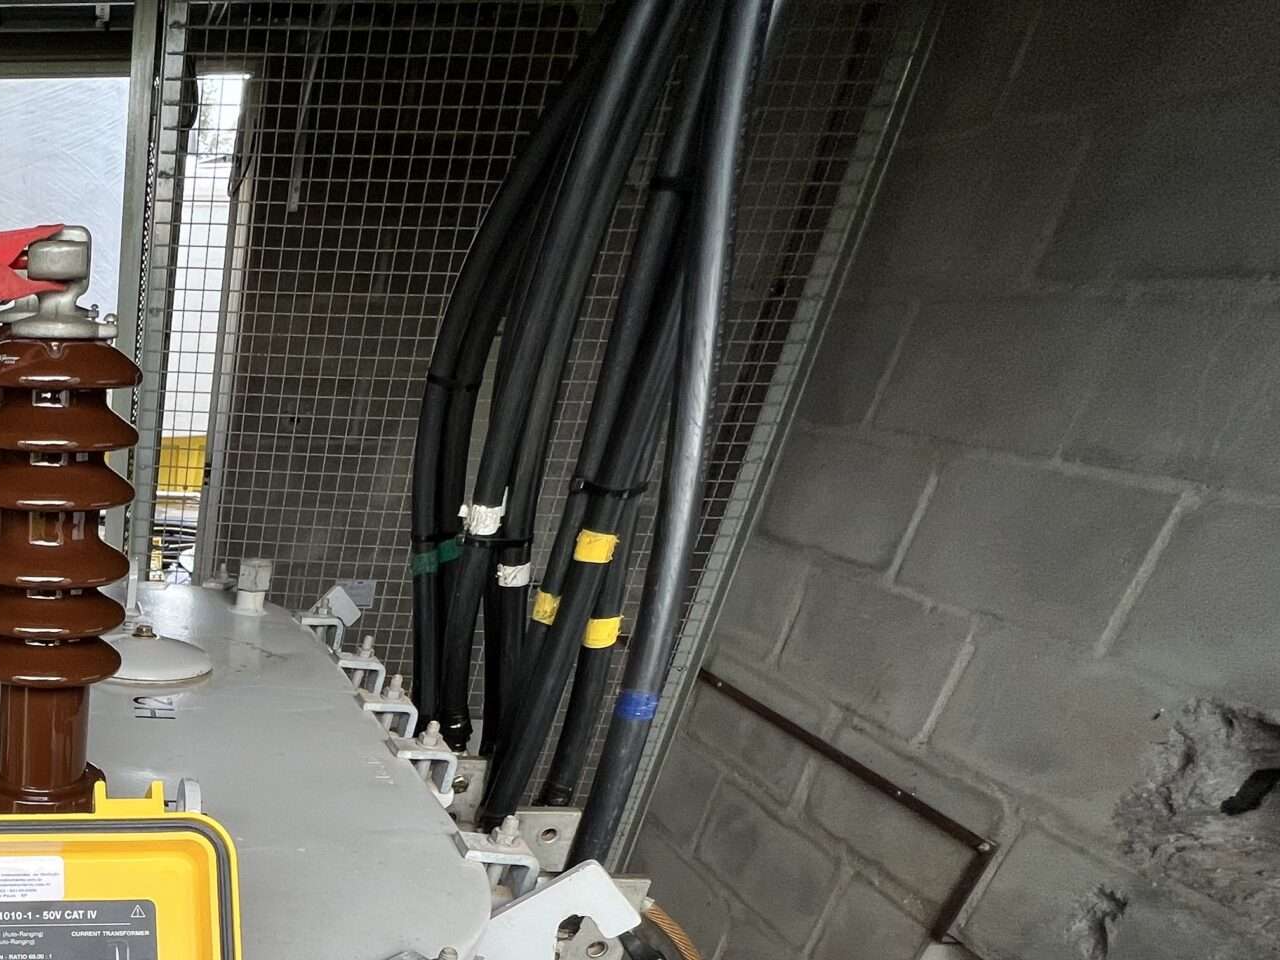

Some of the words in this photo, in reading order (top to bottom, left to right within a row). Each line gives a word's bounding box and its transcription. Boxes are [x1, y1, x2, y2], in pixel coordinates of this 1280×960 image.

[42, 910, 62, 920] 50V
[64, 910, 84, 919] CAT
[87, 910, 97, 919] IV
